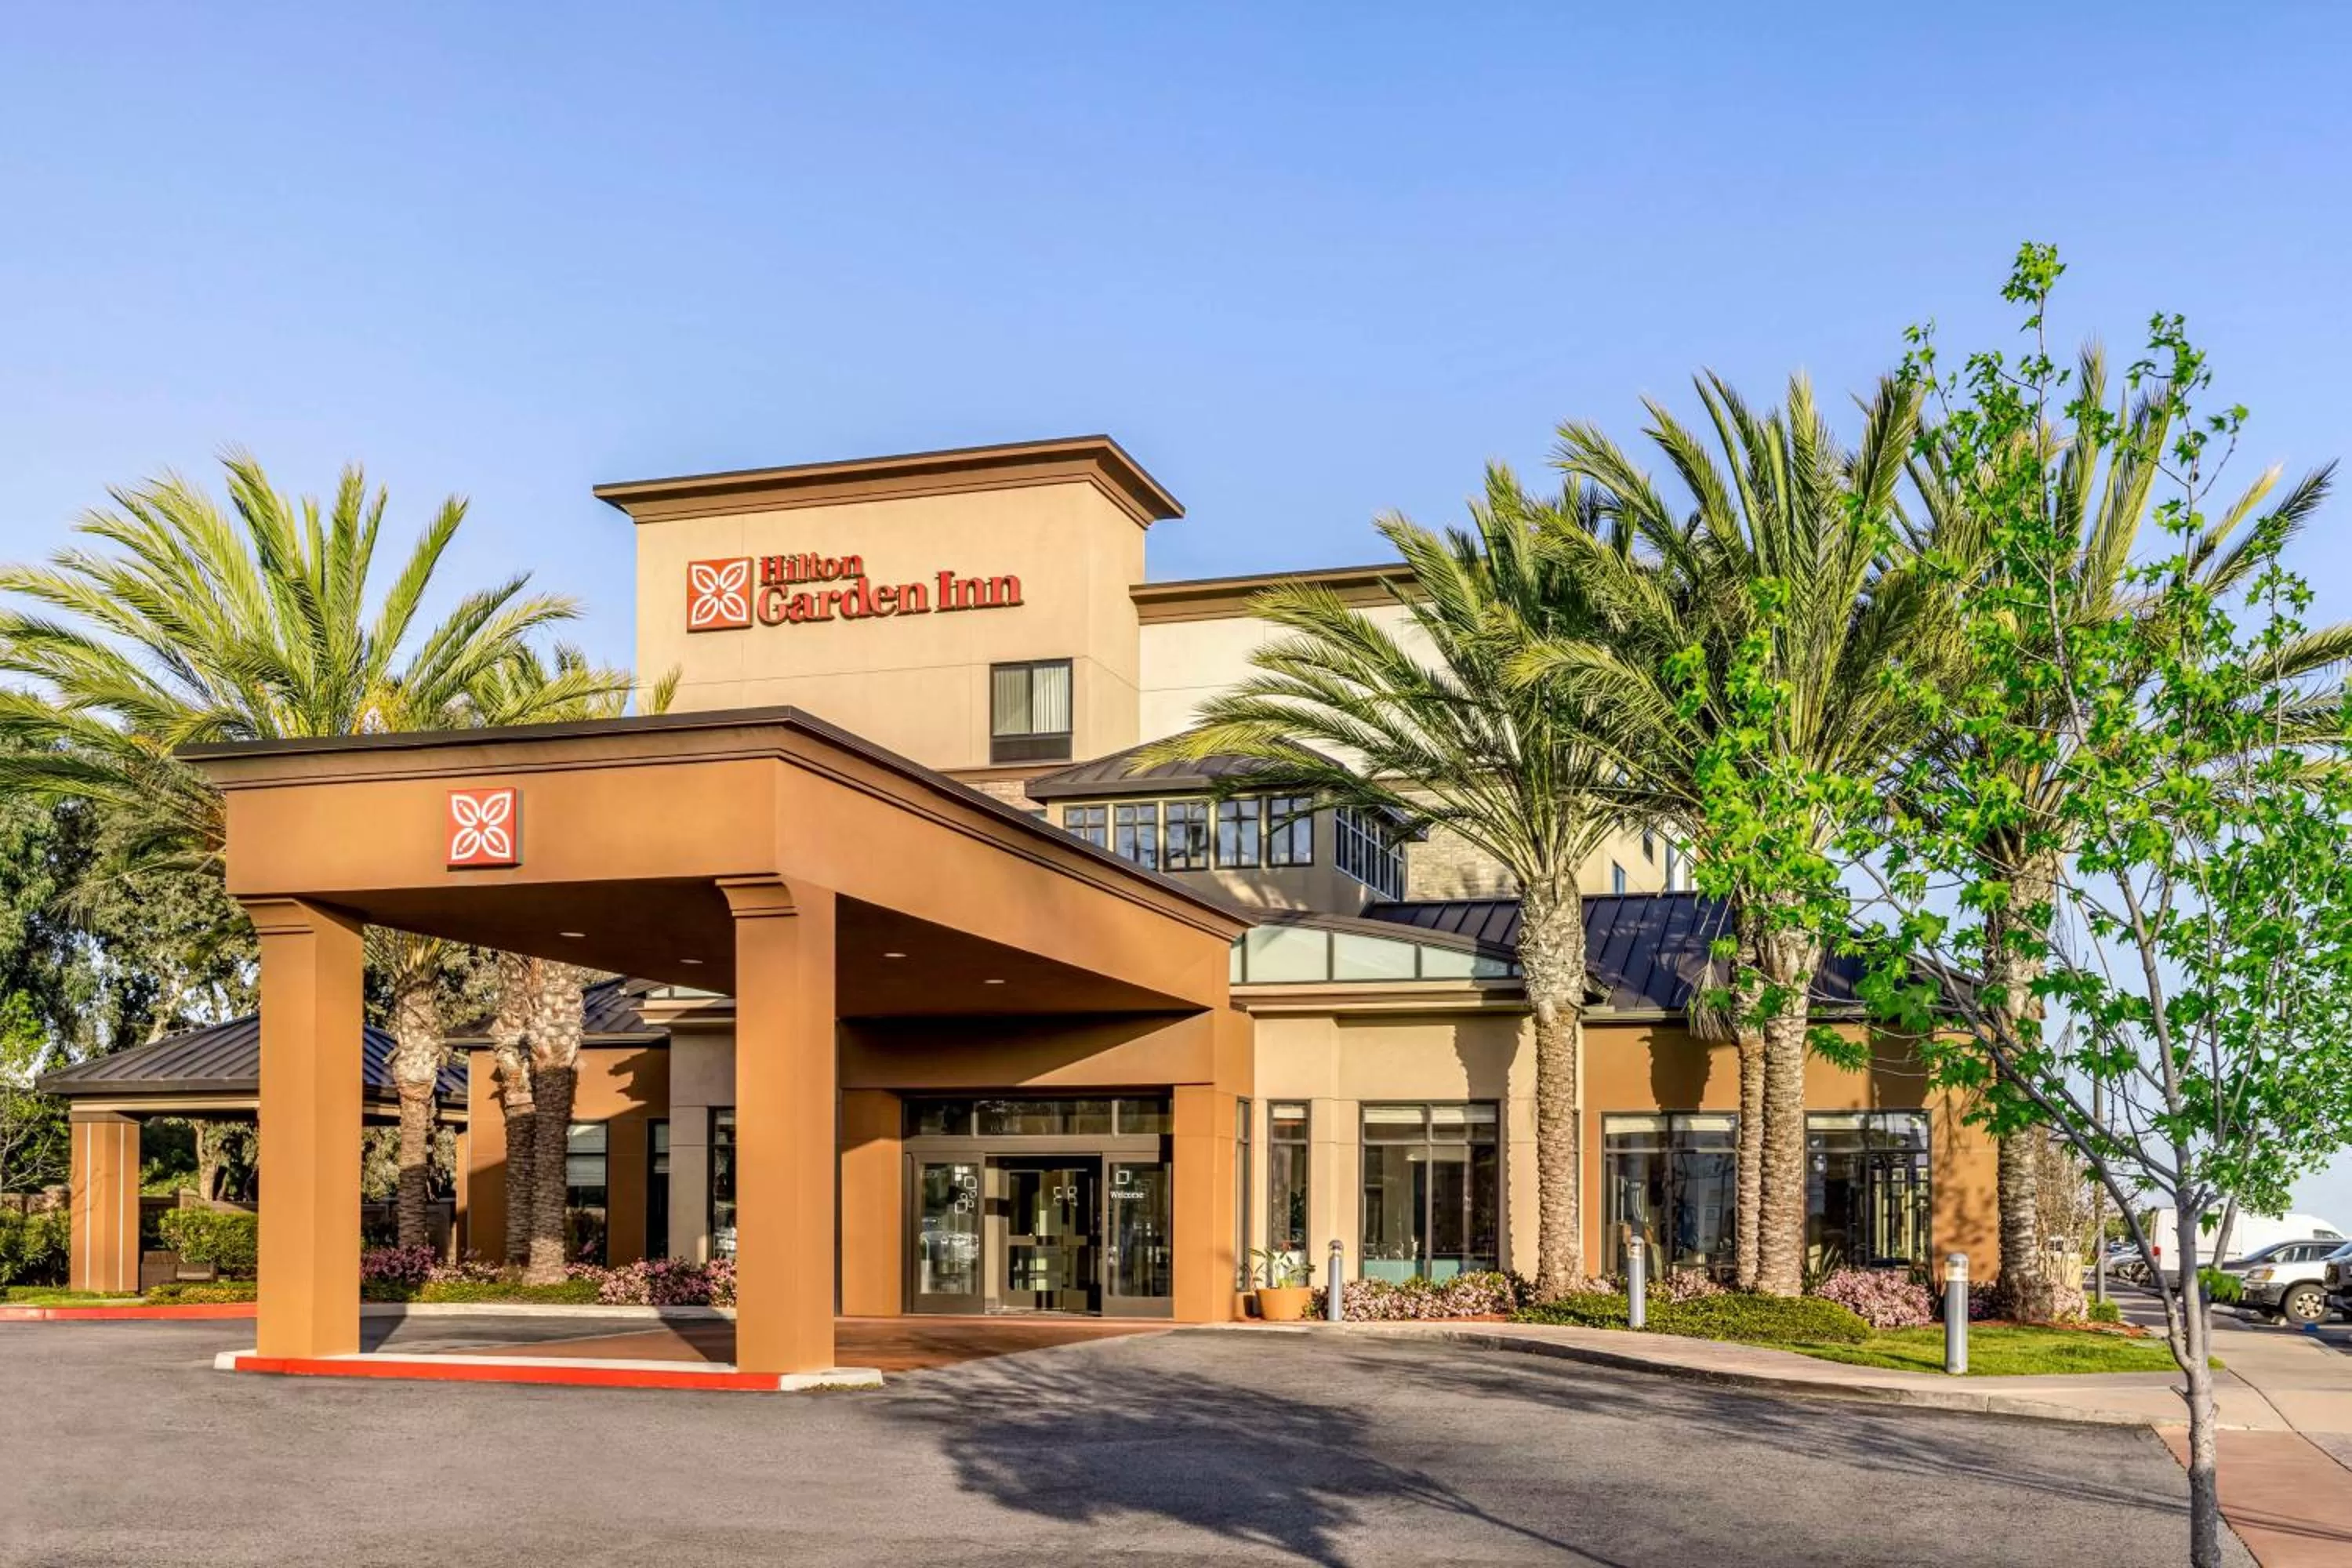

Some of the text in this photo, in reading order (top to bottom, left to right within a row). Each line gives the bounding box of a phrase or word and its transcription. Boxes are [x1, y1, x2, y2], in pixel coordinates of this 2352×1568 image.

[759, 552, 864, 586] Hilton
[757, 570, 1024, 626] Garden Inn
[1110, 1190, 1145, 1199] Welcome
